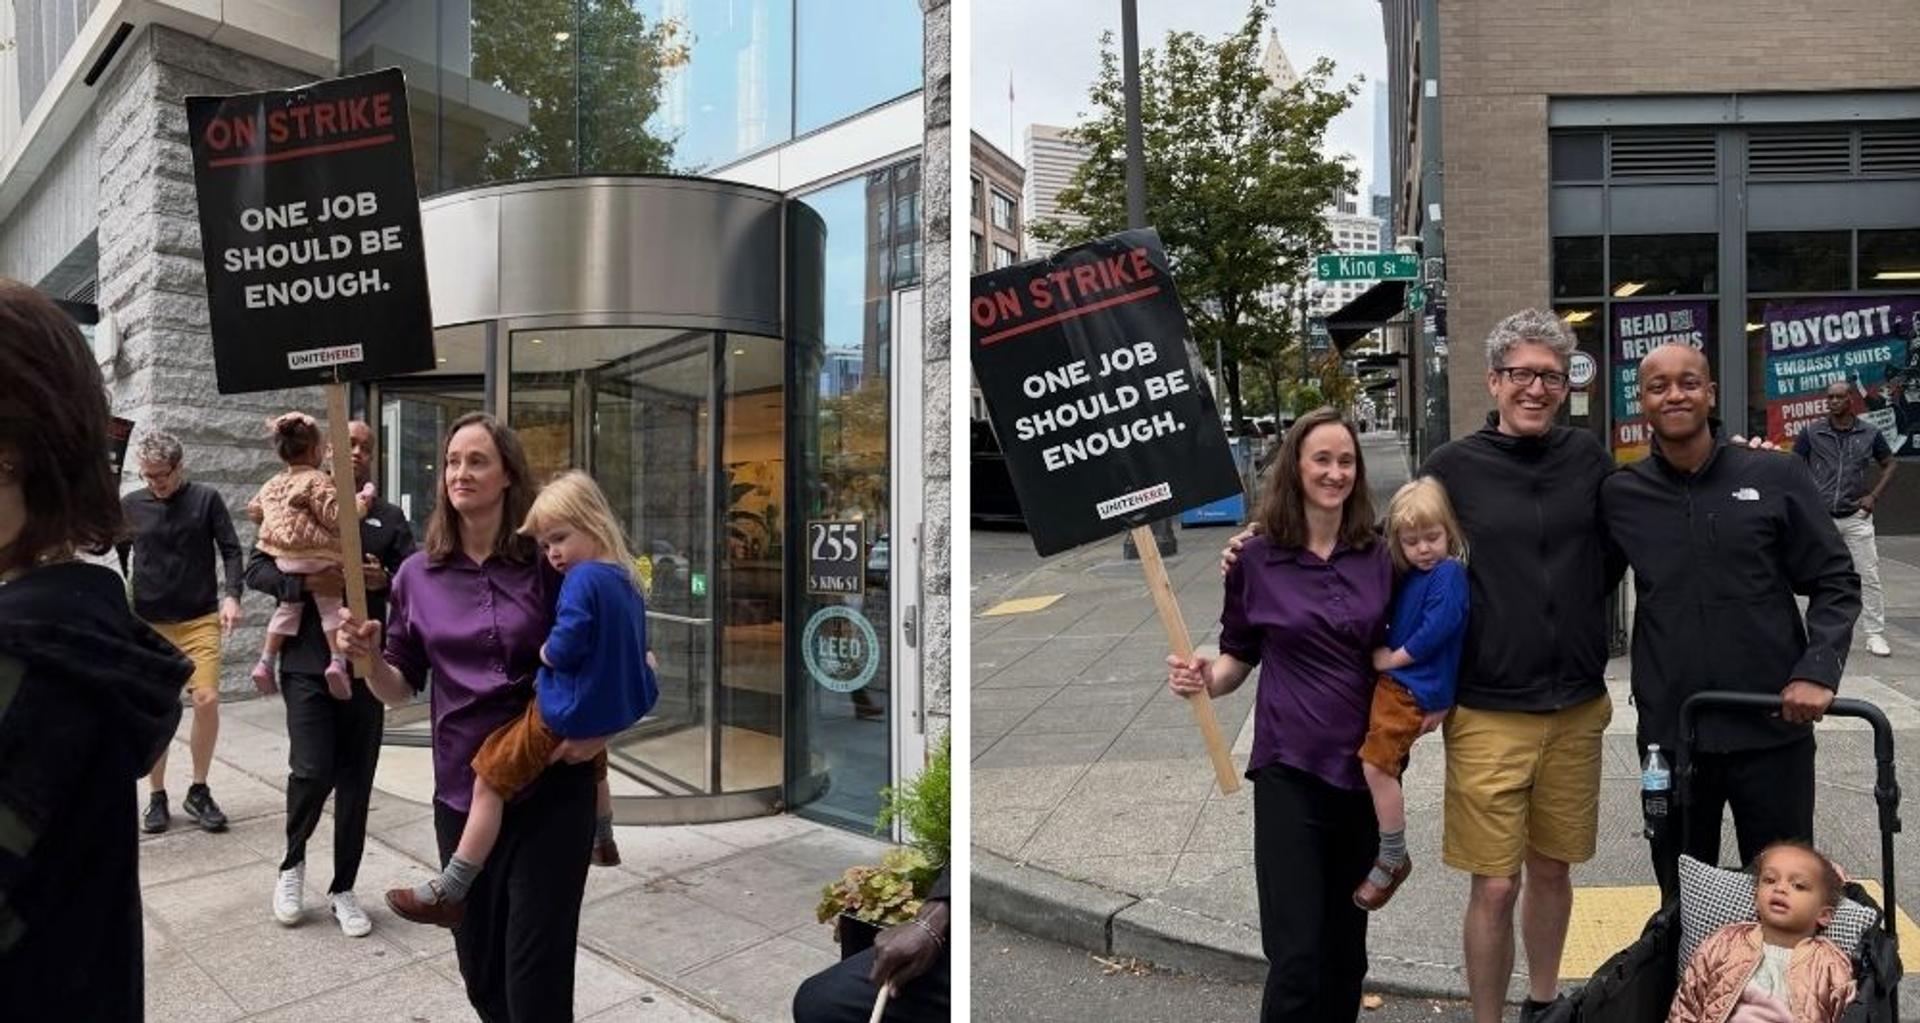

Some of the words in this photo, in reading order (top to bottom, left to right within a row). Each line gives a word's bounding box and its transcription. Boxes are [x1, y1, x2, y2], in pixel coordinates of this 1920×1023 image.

[206, 116, 257, 149] ON
[269, 92, 394, 144] STRIKE
[240, 201, 309, 231] ONE
[317, 192, 378, 222] JOB
[224, 235, 353, 272] SHOULD
[359, 226, 402, 254] BE
[1321, 263, 1330, 276] S
[1340, 257, 1376, 279] King
[1383, 261, 1396, 275] St
[245, 269, 391, 309] ENOUGH.
[971, 288, 1022, 328] ON
[1028, 247, 1155, 309] STRIKE
[1620, 312, 1667, 337] READ
[1770, 305, 1891, 350] BOYCOTT
[1023, 361, 1091, 399] ONE
[1098, 341, 1158, 377] JOB
[1775, 353, 1840, 376] EMBASSY
[1845, 346, 1892, 366] SUITES
[1015, 386, 1139, 441] SHOULD
[1144, 369, 1190, 400] BE
[1778, 378, 1794, 394] BY
[1782, 399, 1831, 419] PIONEE
[1042, 411, 1186, 472] ENOUGH.
[812, 524, 857, 561] 255
[820, 576, 844, 589] KING
[818, 635, 861, 659] LEED
